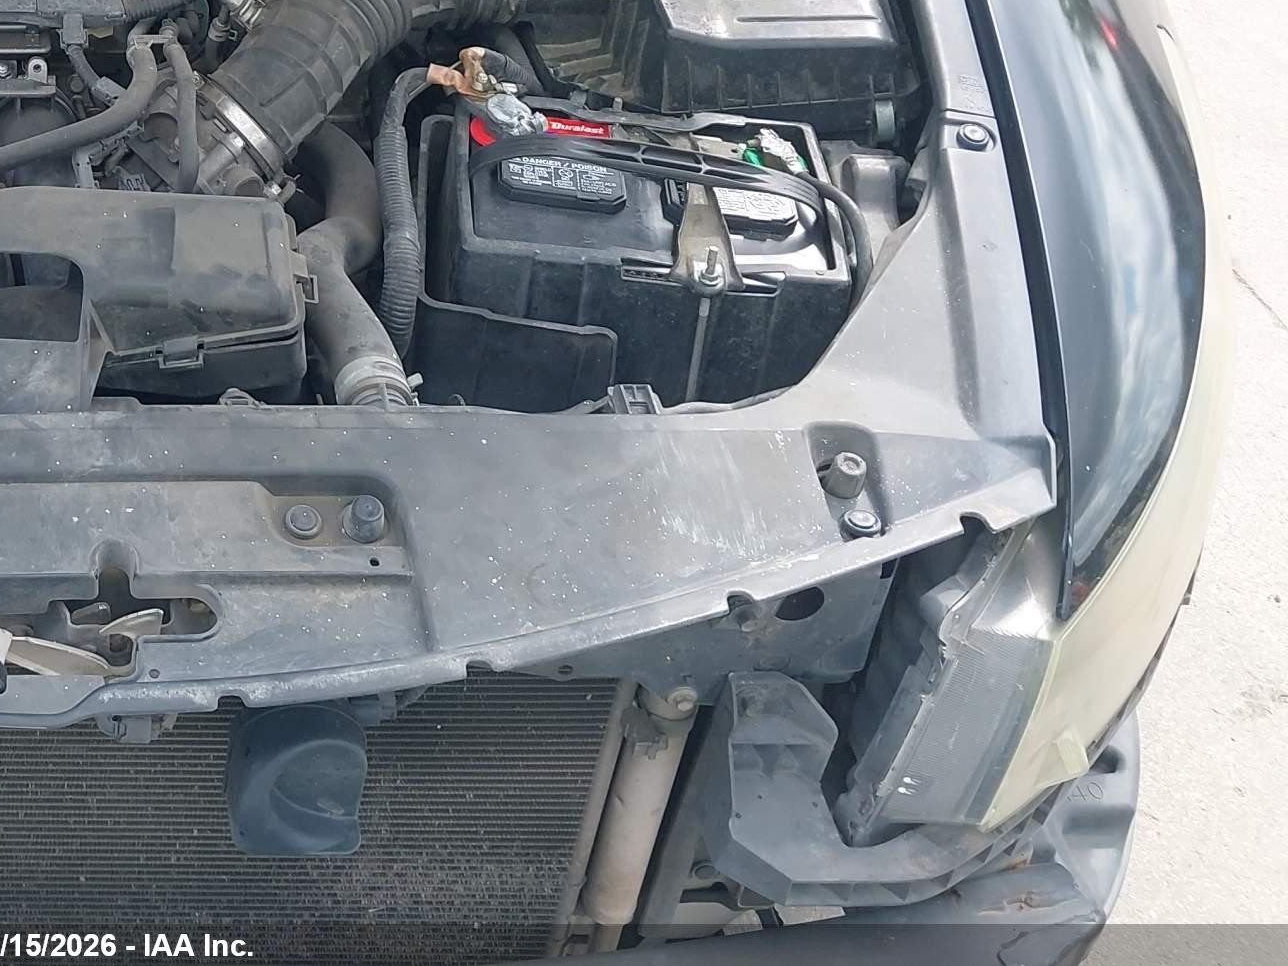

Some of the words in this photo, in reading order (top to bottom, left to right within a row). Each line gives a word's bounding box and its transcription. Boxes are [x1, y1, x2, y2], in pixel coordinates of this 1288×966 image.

[550, 121, 605, 134] Duralast
[522, 157, 562, 168] DANGER
[571, 163, 607, 173] POISON
